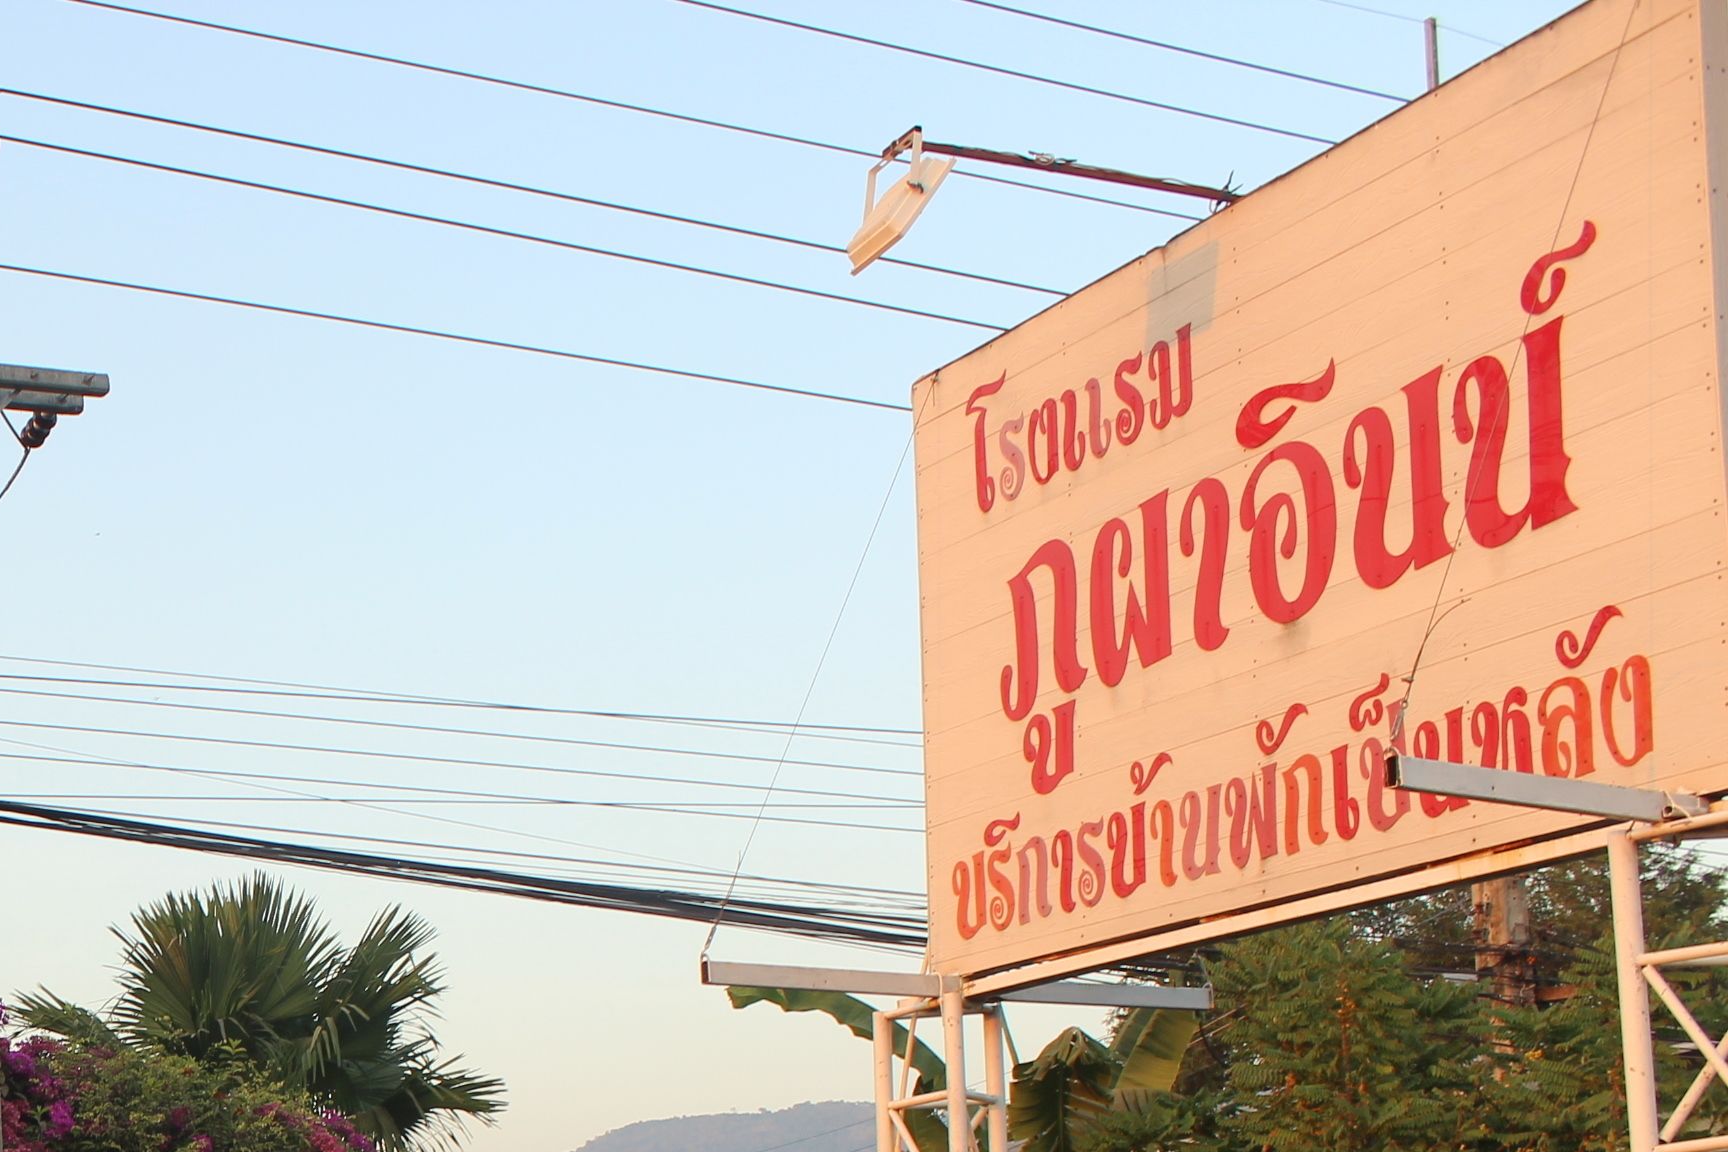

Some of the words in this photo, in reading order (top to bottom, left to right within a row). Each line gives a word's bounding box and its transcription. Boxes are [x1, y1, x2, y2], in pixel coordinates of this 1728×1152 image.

[965, 322, 1193, 513] โรงแรม
[1000, 220, 1596, 795] ภูผาอินน์
